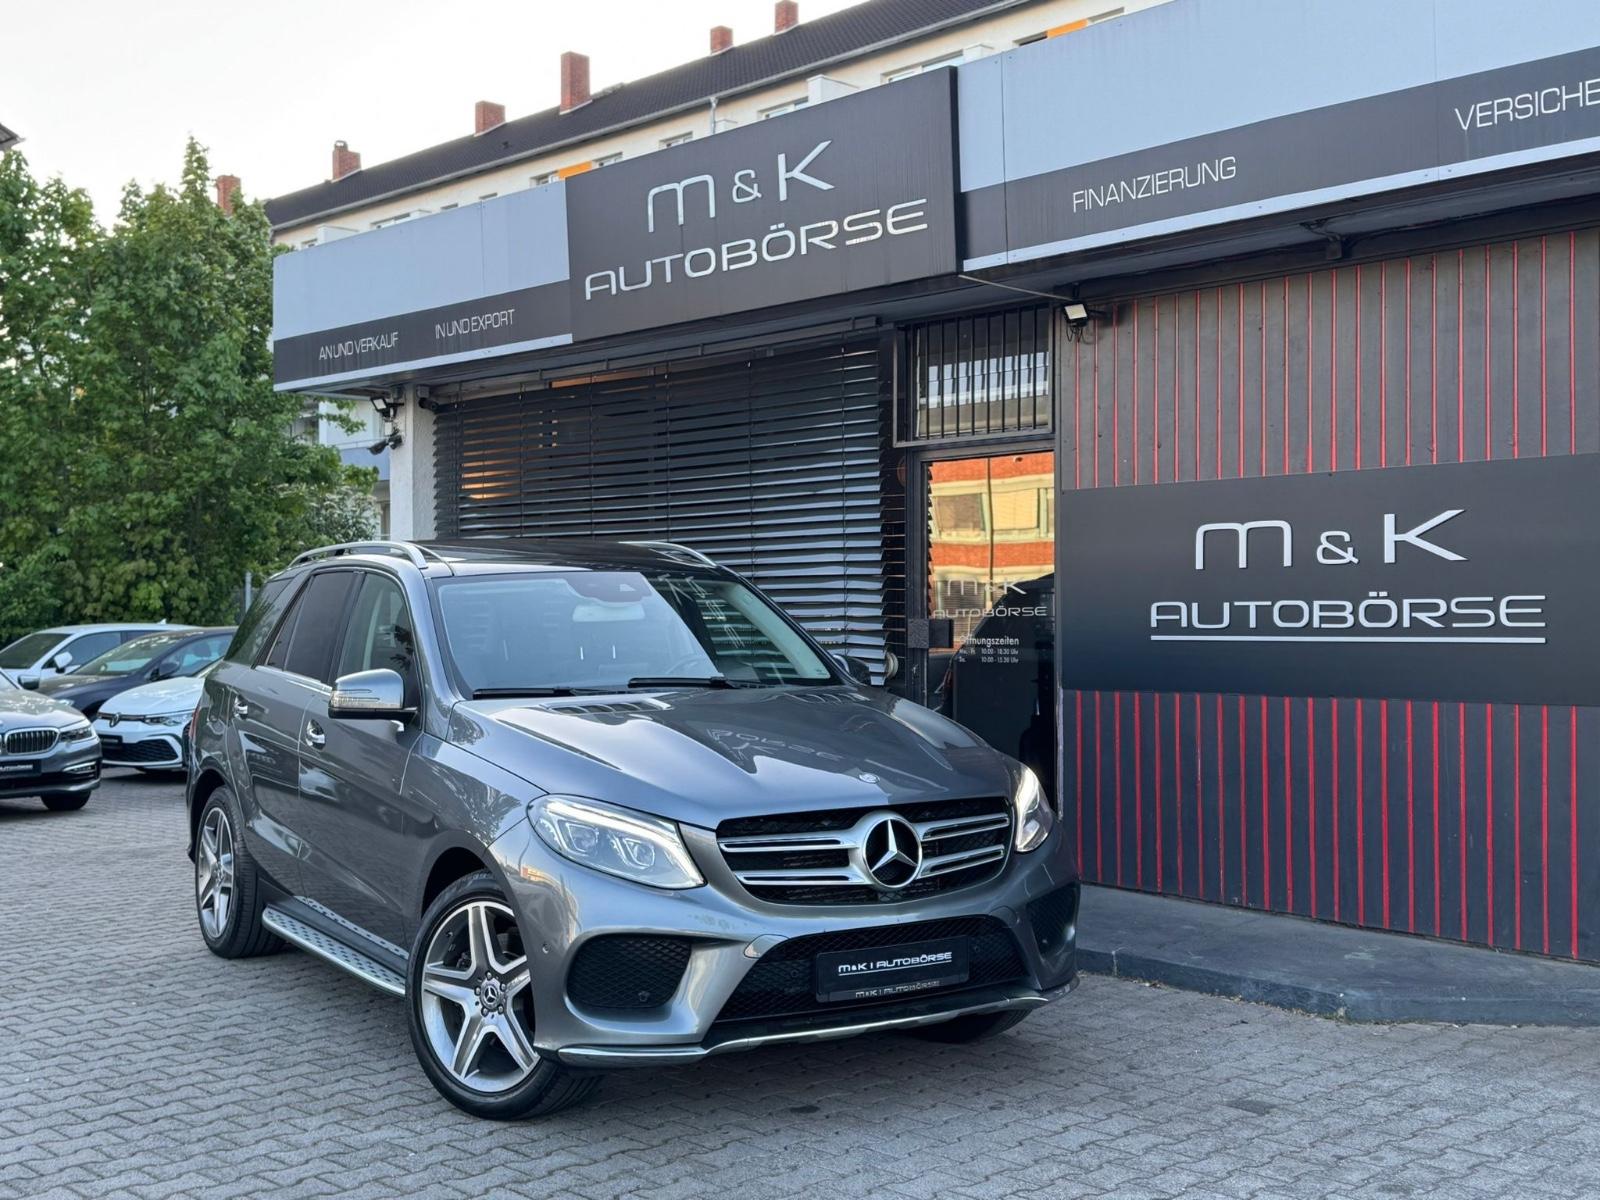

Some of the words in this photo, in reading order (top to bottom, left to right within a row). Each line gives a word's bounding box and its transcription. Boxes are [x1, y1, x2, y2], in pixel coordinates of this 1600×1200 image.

[1454, 78, 1600, 131] VERSICHE
[732, 169, 762, 203] &
[777, 139, 835, 202] K
[1072, 156, 1237, 213] FINANZIERUNG
[584, 198, 929, 300] AUTOBÖRSE
[471, 309, 515, 332] EXPORT
[354, 331, 399, 354] VERKAUF
[1316, 530, 1359, 565] &
[1383, 509, 1469, 564] K
[1003, 578, 1028, 595] K
[932, 605, 1049, 619] AUTOBÖRSE
[1150, 591, 1547, 629] AUTOBÖRSE
[876, 951, 953, 969] AUTOBÖRSE
